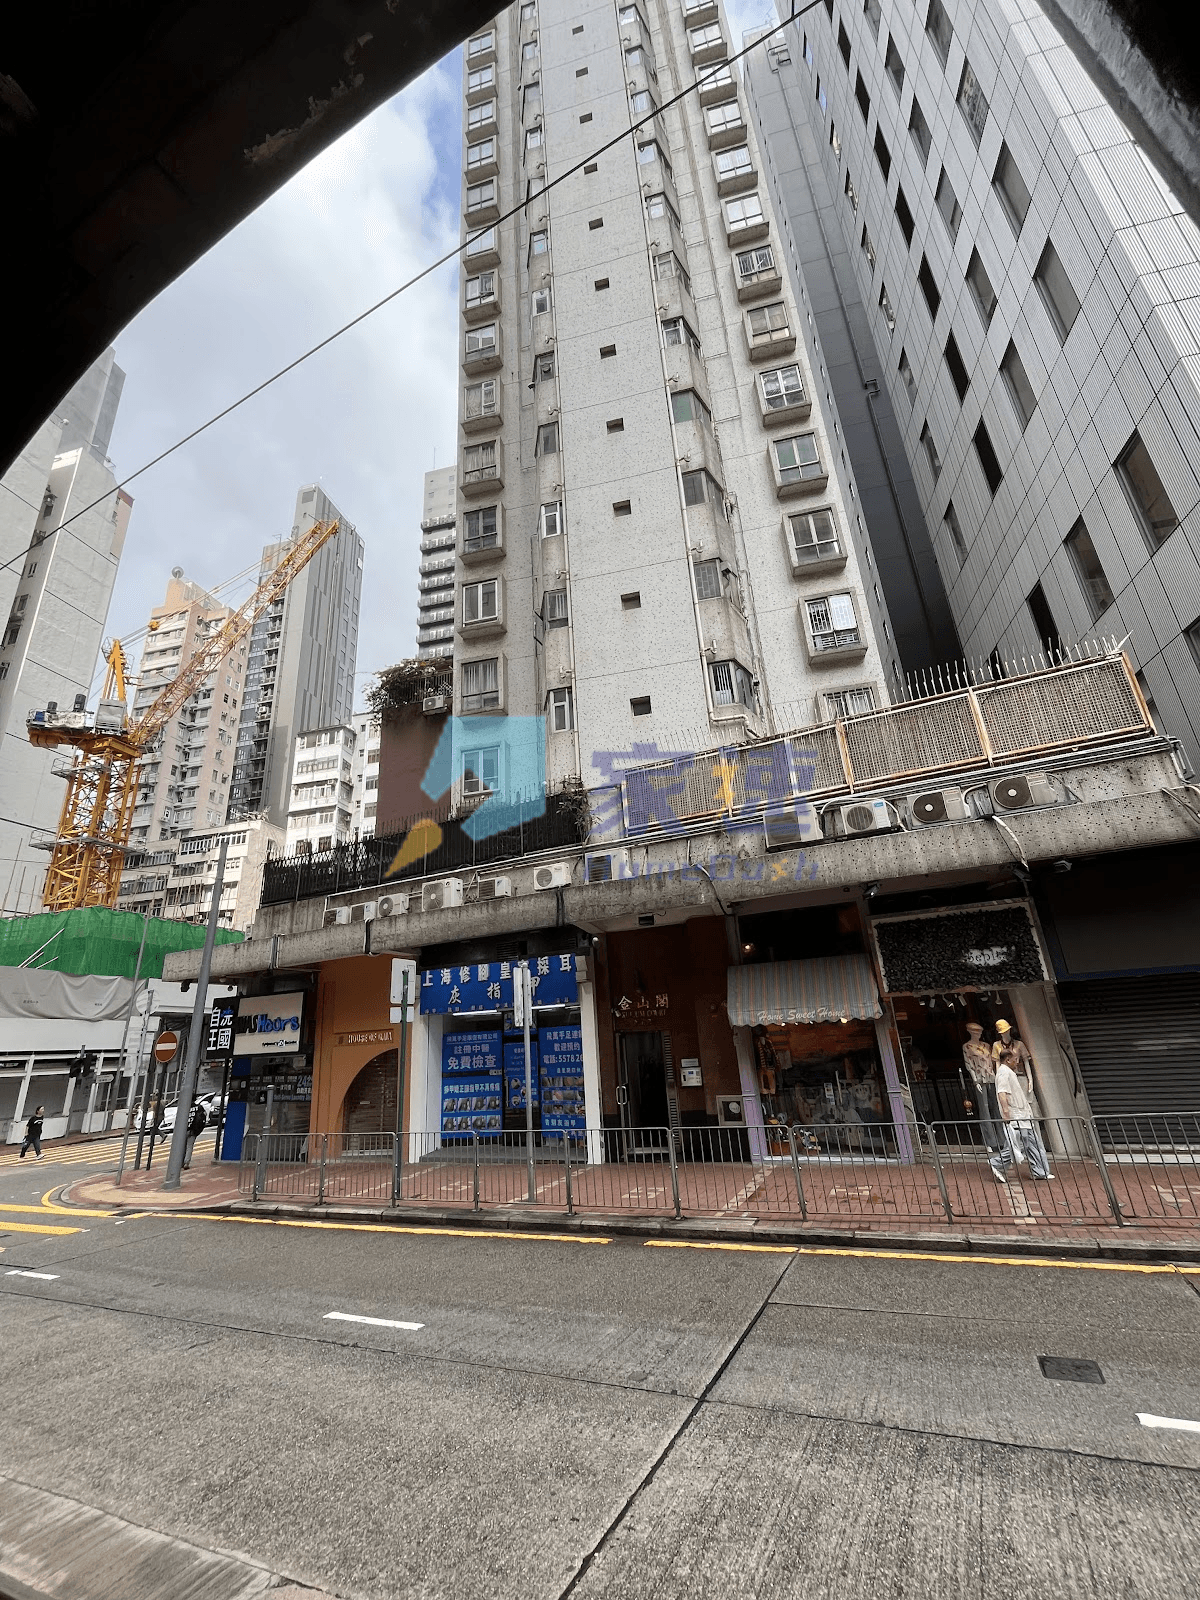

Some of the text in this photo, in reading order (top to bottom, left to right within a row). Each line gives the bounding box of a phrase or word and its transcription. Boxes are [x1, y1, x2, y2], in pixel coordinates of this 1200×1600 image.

[423, 953, 572, 987] 上海修腳皇採耳
[617, 993, 669, 1011] 金山閣
[757, 1007, 846, 1021] Home Sweet Home
[348, 1033, 368, 1044] HOUSE
[447, 1053, 496, 1070] 免費檢查
